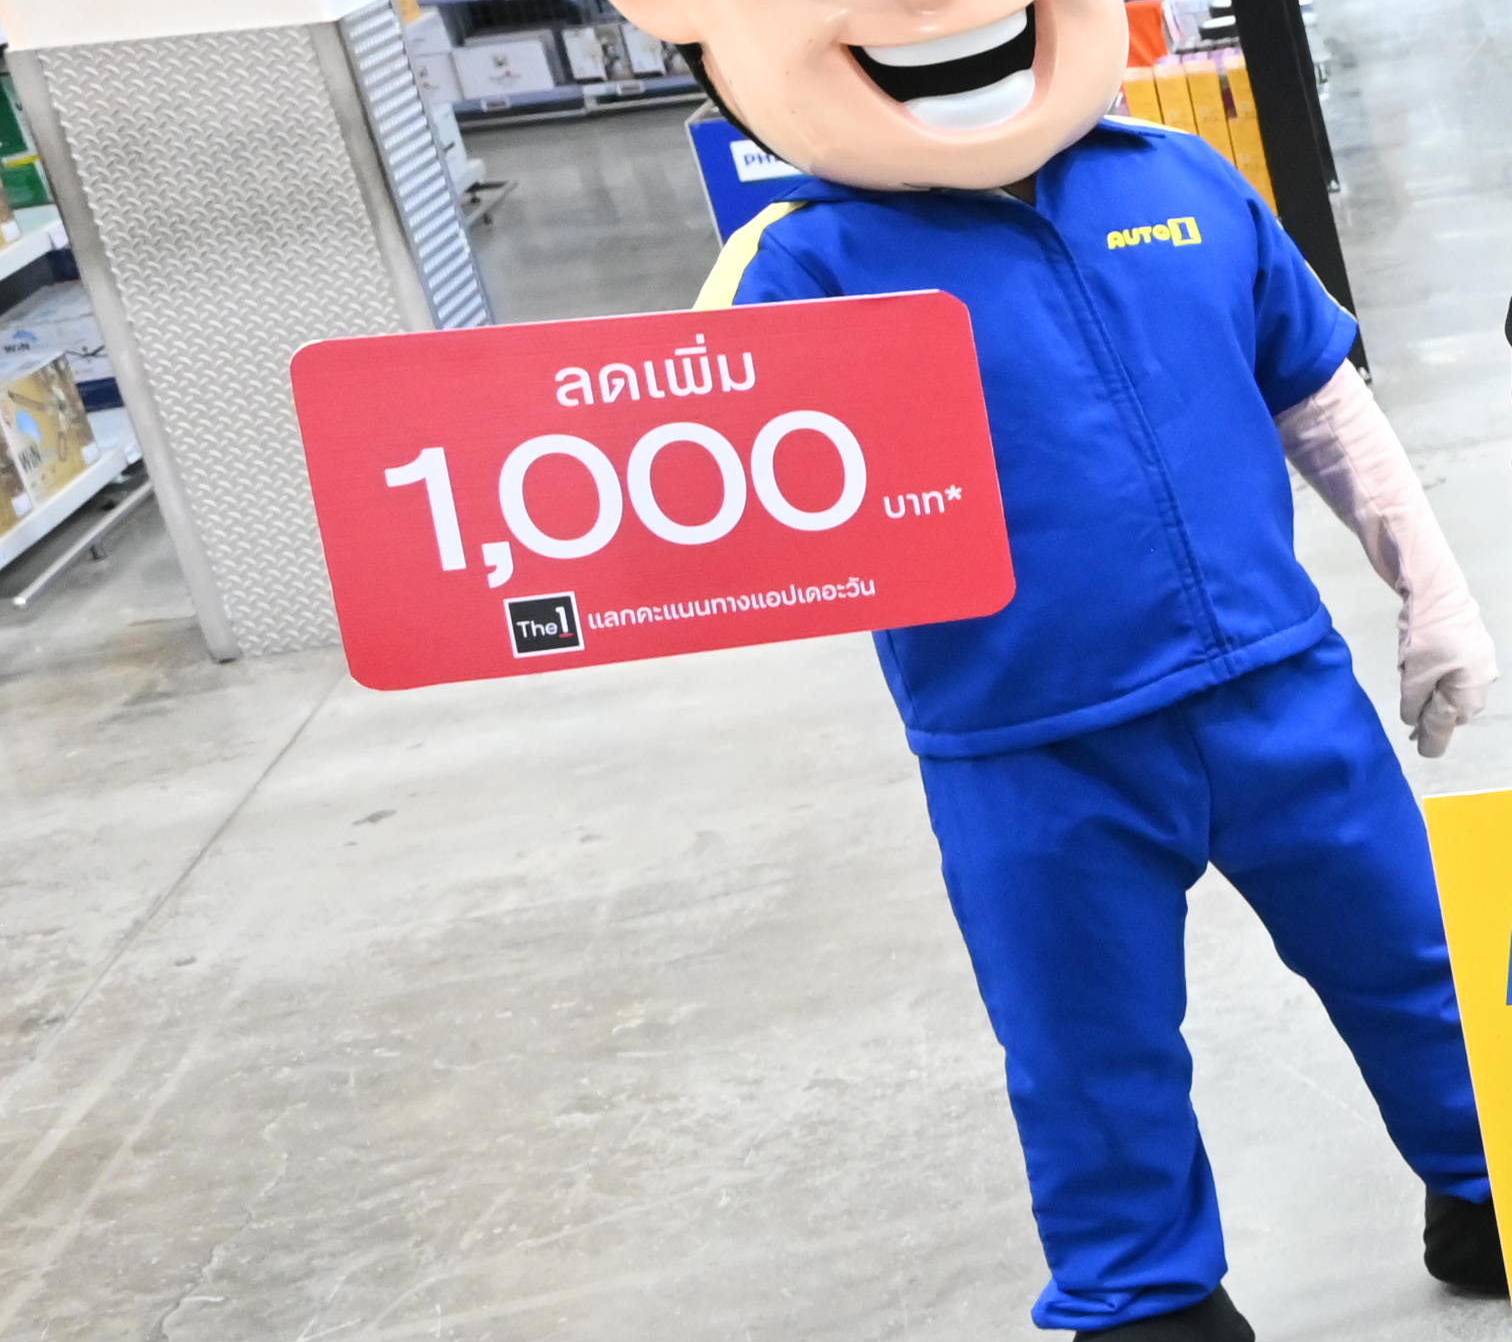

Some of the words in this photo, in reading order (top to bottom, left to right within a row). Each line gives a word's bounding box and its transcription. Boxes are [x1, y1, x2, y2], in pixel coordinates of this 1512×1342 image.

[553, 333, 758, 408] ลดเพิ่ม
[384, 409, 867, 589] 1,000
[587, 576, 877, 632] แลกคะแนนทางแอปเดอะวัน
